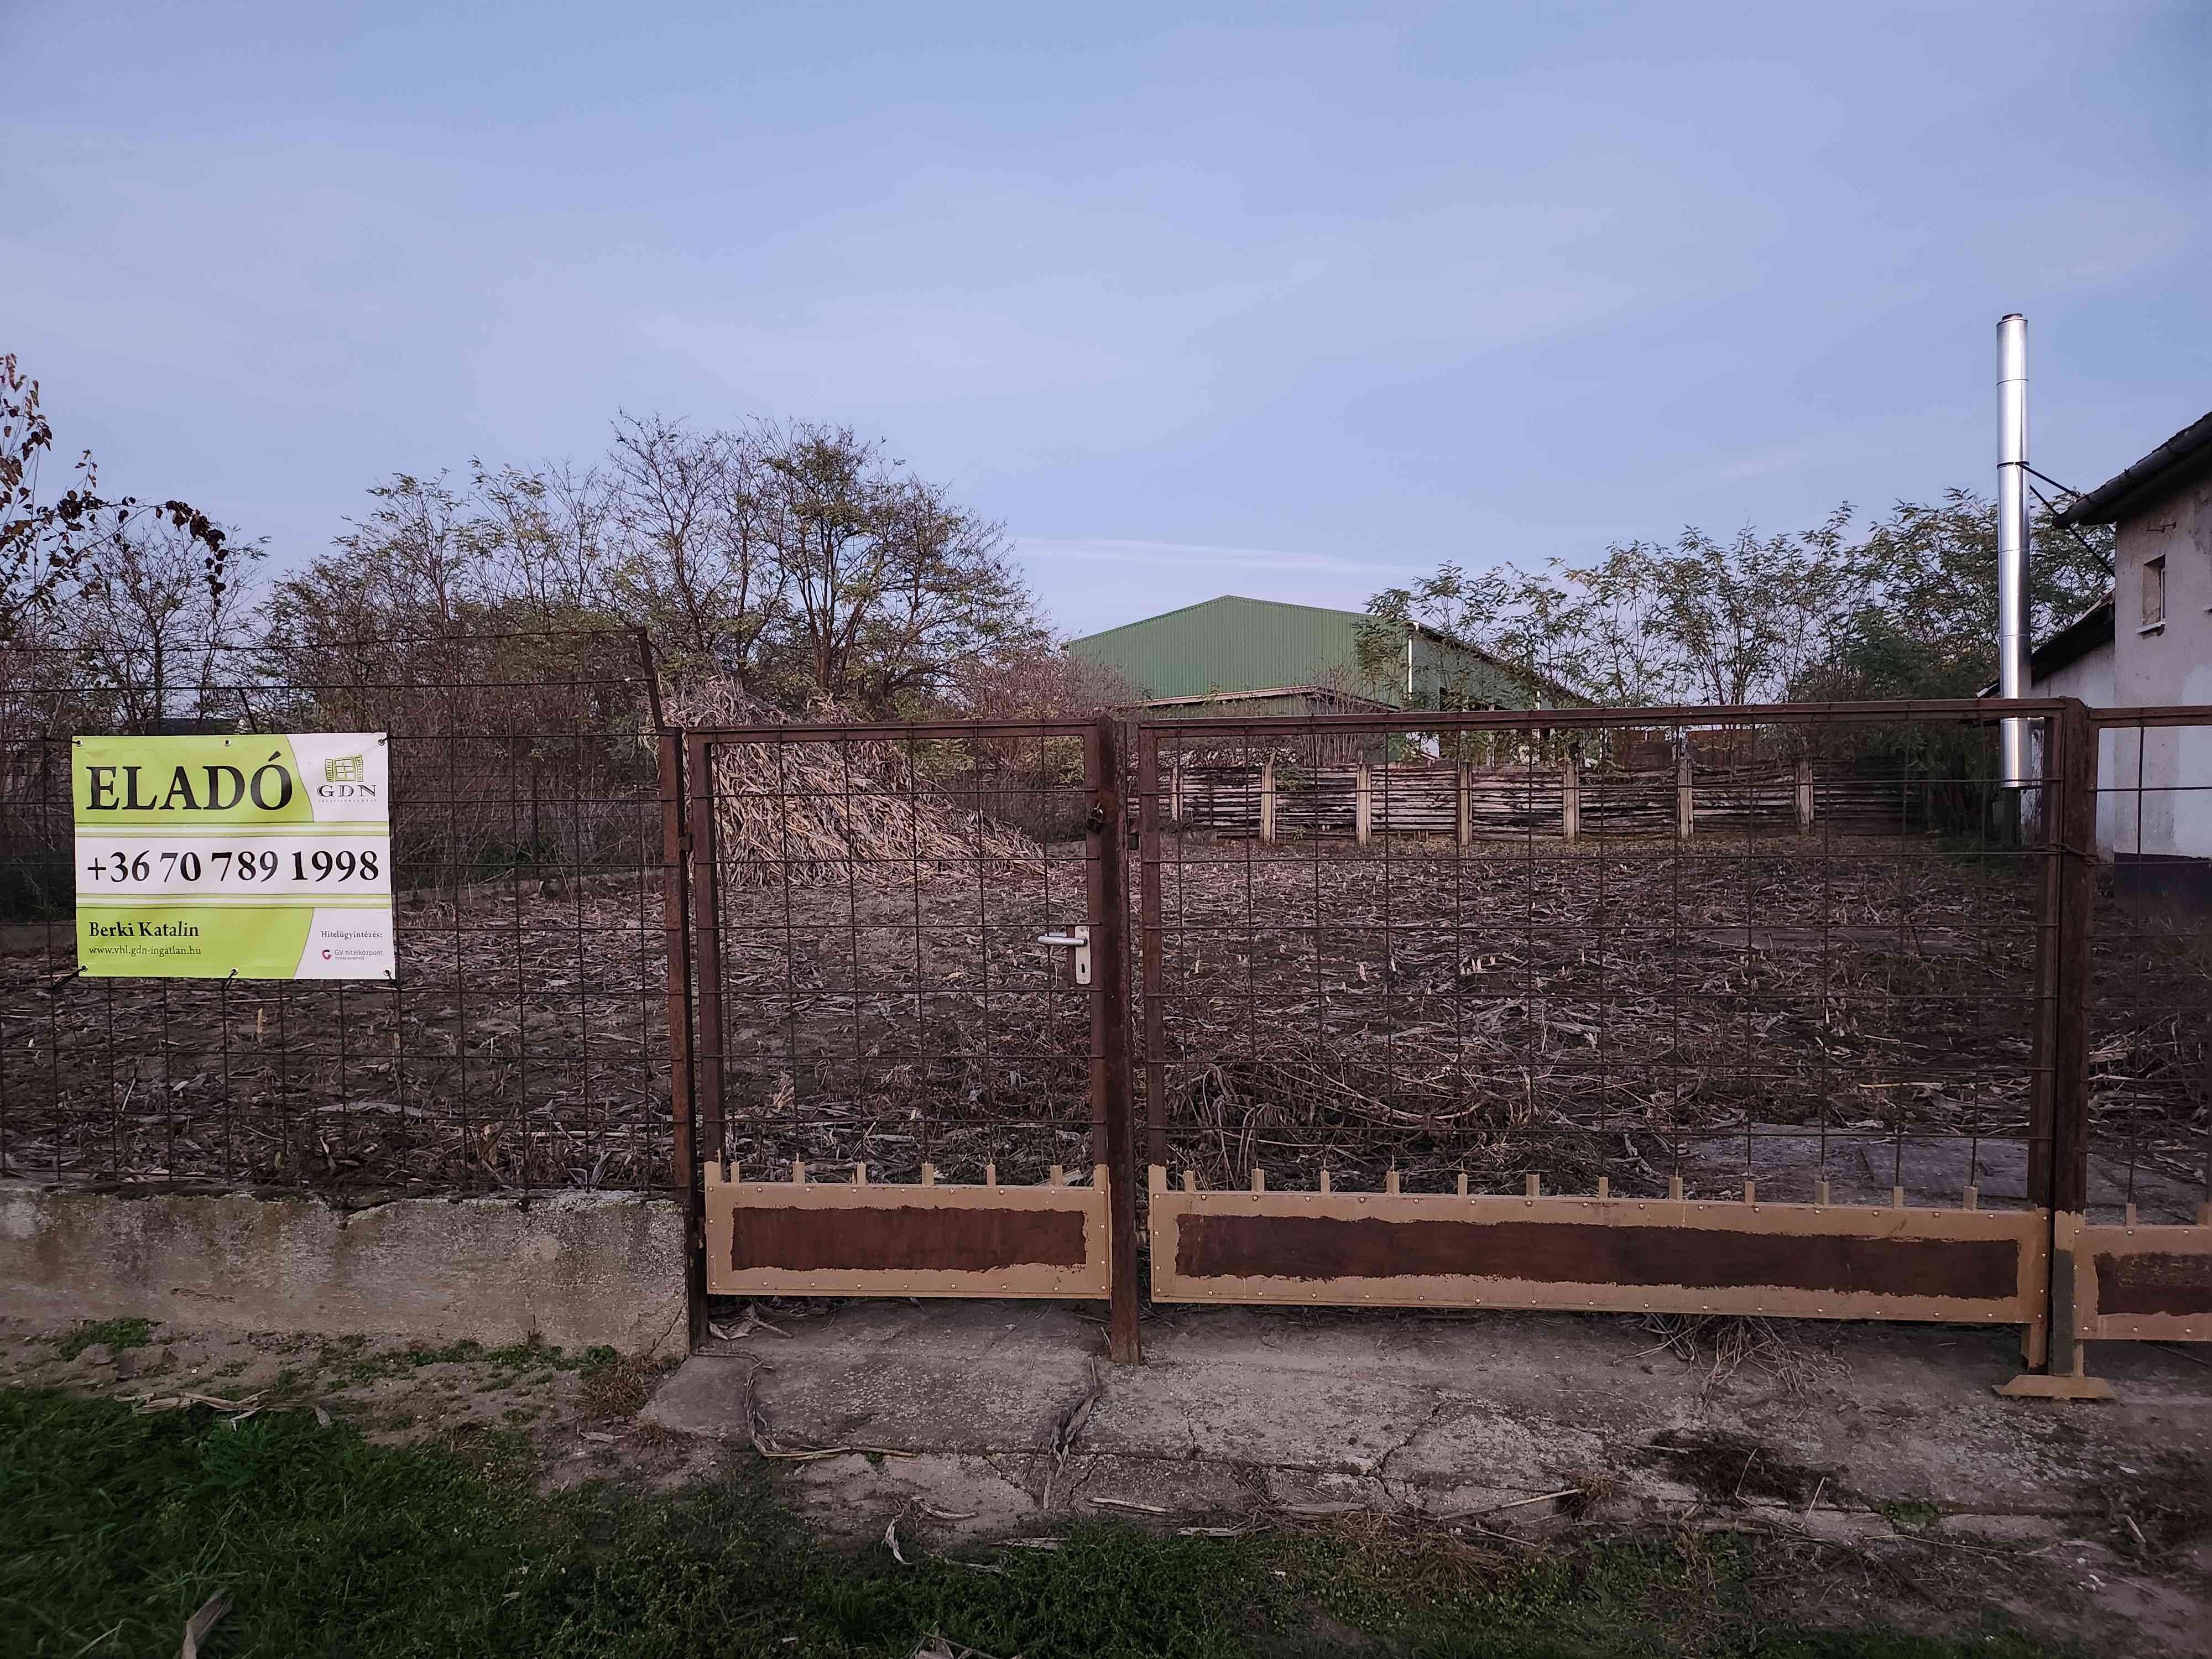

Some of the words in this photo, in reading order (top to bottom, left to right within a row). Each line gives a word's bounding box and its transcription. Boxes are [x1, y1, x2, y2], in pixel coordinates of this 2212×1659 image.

[86, 750, 293, 811] ELADÓ
[317, 784, 378, 797] GDN
[87, 850, 150, 883] +36
[160, 852, 201, 883] 70
[211, 851, 278, 883] 789
[291, 851, 379, 883] 1998
[88, 921, 135, 937] Berki
[138, 921, 200, 937] Katalin
[321, 931, 383, 941] Hitelügyintézés:
[88, 945, 202, 957] www.vhl.gdn-ingatlan.hu
